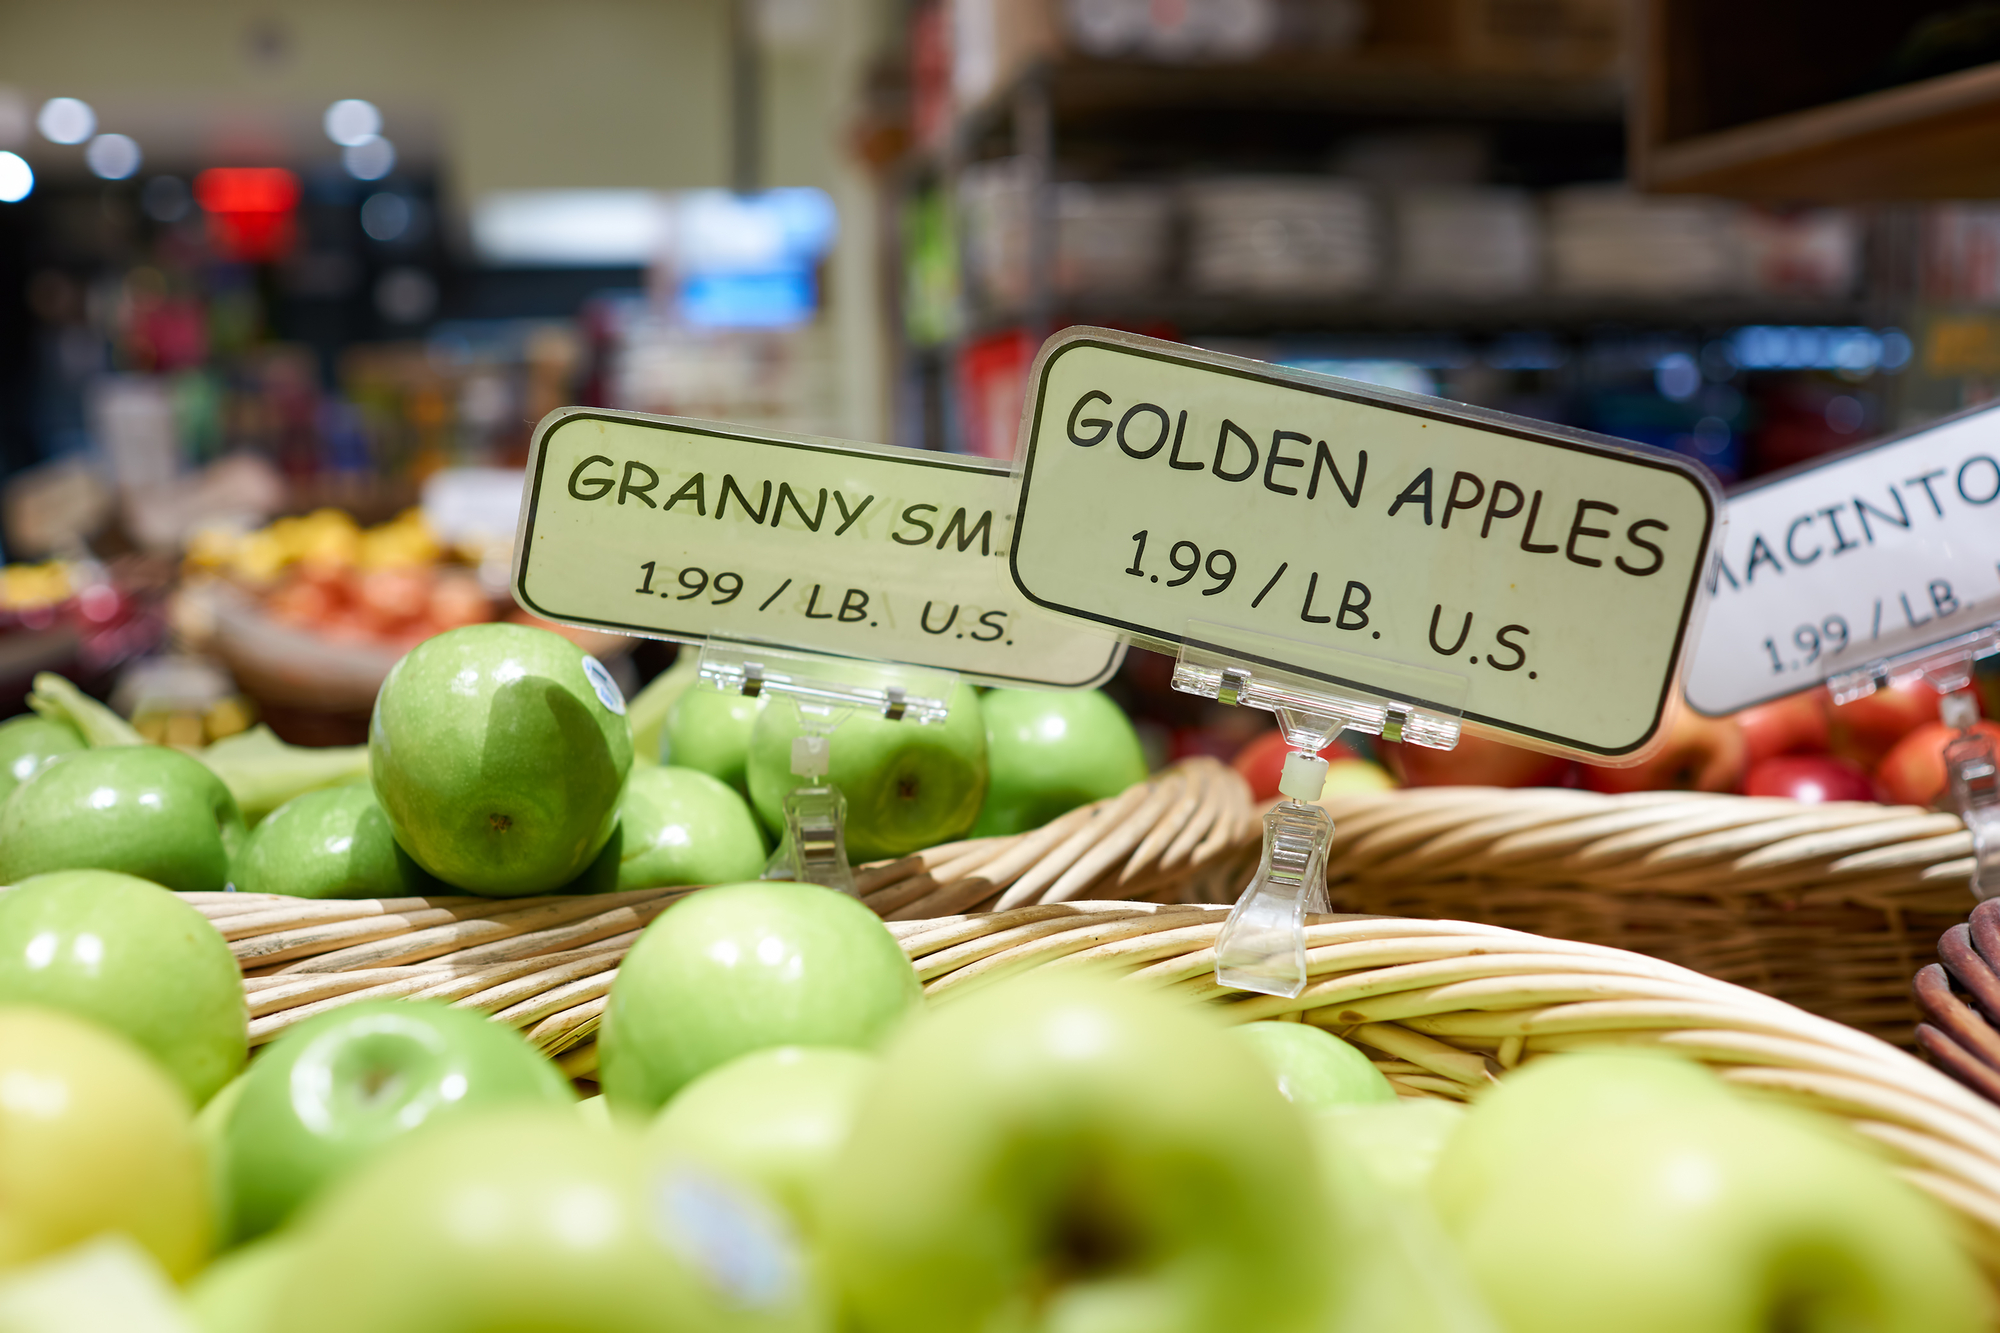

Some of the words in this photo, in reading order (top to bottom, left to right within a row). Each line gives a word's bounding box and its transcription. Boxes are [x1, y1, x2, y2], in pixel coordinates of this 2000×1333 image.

[567, 454, 874, 536] GRANNY
[1066, 389, 1368, 508] GOLDEN
[1388, 467, 1669, 576] APPLES
[635, 560, 744, 605] 1.99
[758, 578, 793, 612] /
[804, 583, 878, 627] LB.
[920, 600, 1013, 646] U.S.
[1125, 530, 1237, 597] 1.99
[1251, 561, 1289, 609] /
[1301, 572, 1381, 640] LB.
[1429, 603, 1537, 680] U.S.
[1763, 614, 1850, 674] 1.99
[1871, 597, 1883, 641] /
[1900, 578, 1975, 629] LB.
